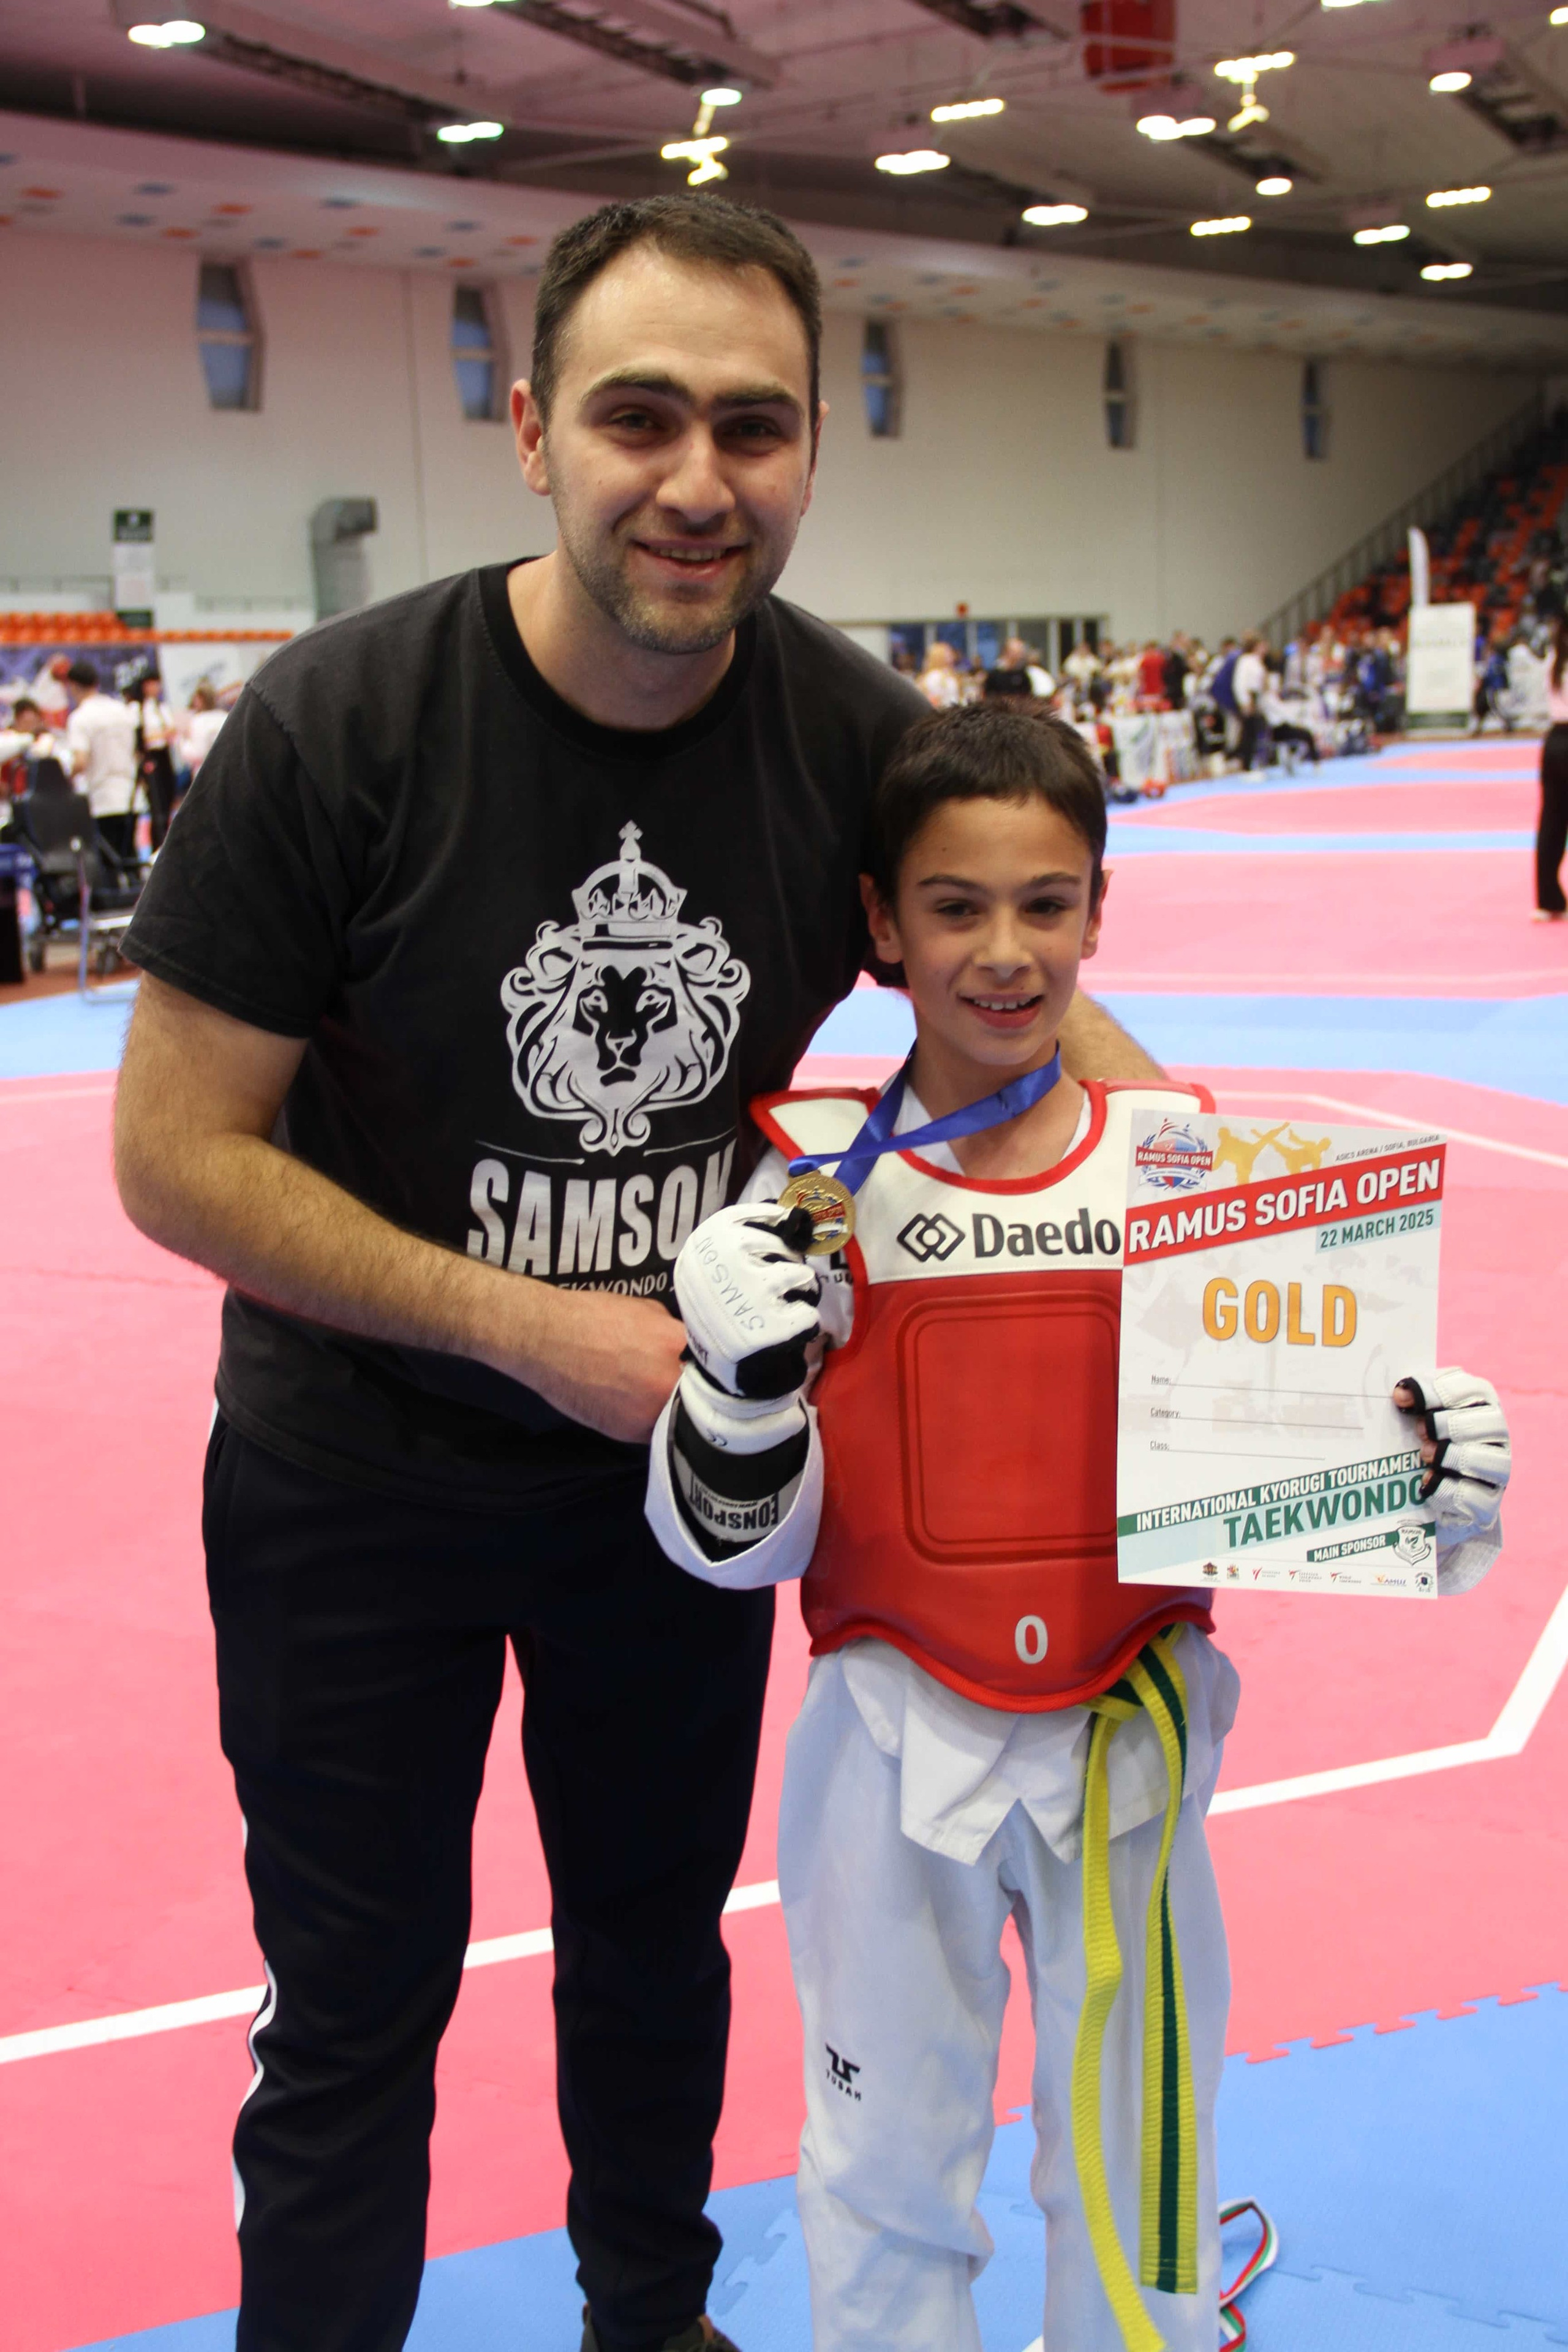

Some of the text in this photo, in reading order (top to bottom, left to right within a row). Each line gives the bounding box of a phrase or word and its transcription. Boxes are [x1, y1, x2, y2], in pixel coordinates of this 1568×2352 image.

[1137, 1151, 1212, 1166] RAMUS SOFIA OPEN
[467, 1136, 737, 1276] SAMSON
[1128, 1158, 1441, 1254] RAMUS SOFIA OPEN
[1320, 1208, 1434, 1249] 22 MARCH 2025
[972, 1207, 1121, 1258] Daedo
[696, 1237, 764, 1330] SAMSON
[1202, 1276, 1357, 1348] GOLD
[1151, 1374, 1172, 1385] Name:
[1150, 1407, 1181, 1419] Category:
[1150, 1440, 1170, 1451] Class:
[1136, 1490, 1256, 1532] INTERNATIONAL
[1259, 1476, 1325, 1505] KYORUGI
[1223, 1474, 1427, 1548] TAEKWONDO
[1313, 1533, 1387, 1563] MAIN SPONSOR
[1014, 1615, 1049, 1664] 0
